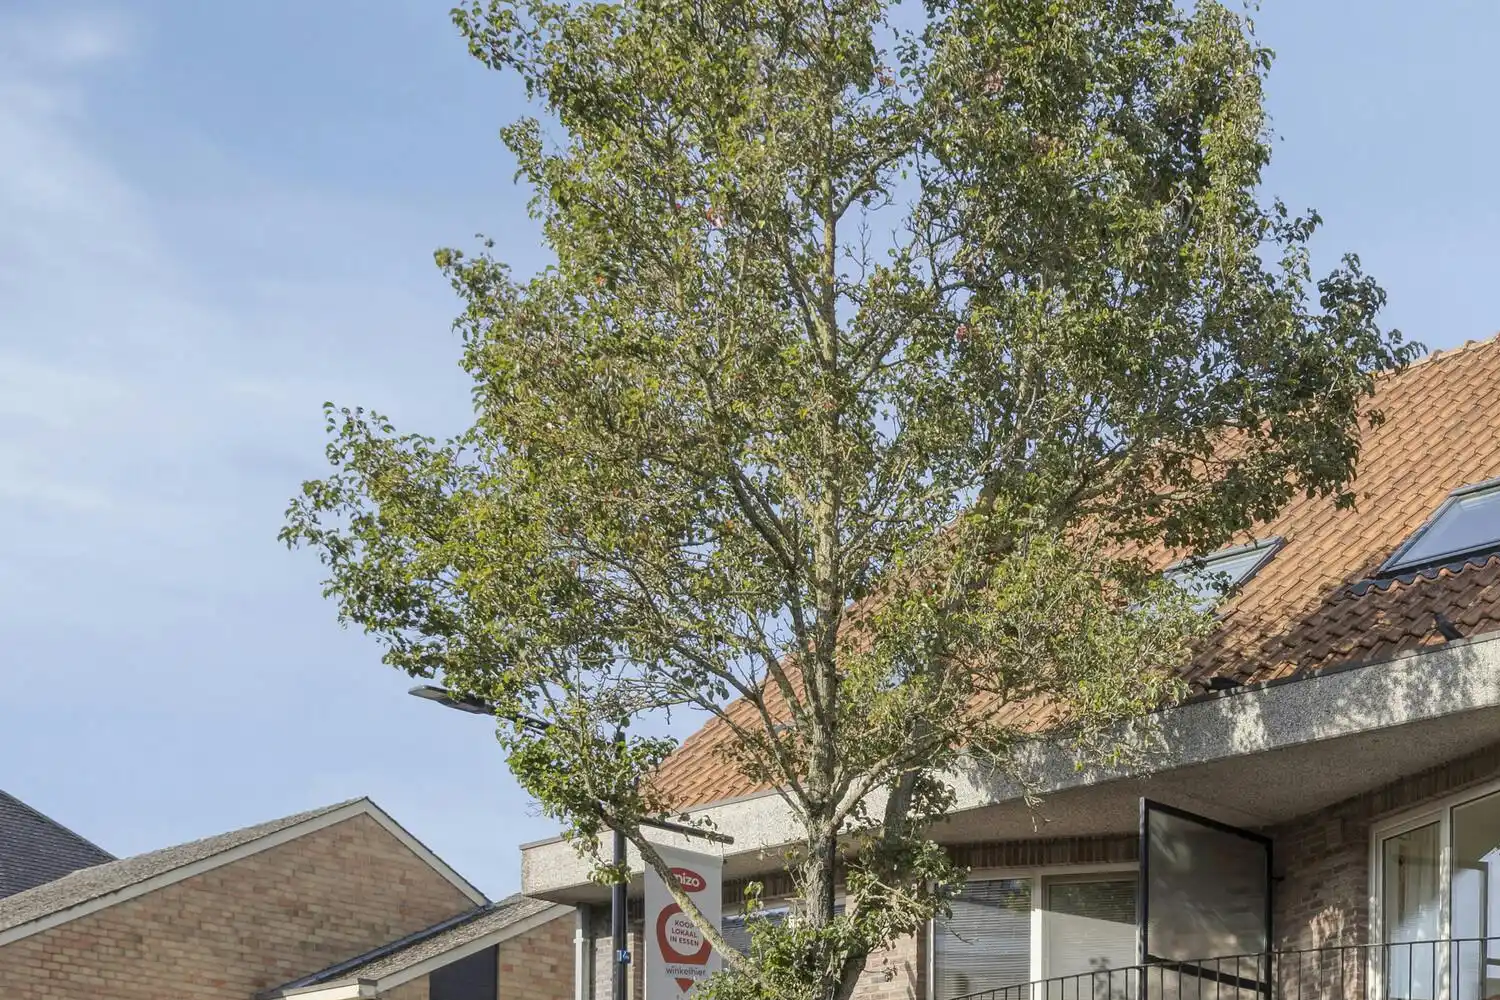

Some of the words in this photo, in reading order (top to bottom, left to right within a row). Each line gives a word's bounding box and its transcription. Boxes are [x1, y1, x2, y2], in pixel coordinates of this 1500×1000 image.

[671, 872, 700, 888] nizo
[674, 919, 695, 929] KOOP
[671, 927, 697, 938] LOKAAL
[669, 935, 678, 943] IN
[679, 937, 699, 947] ESSEN
[665, 965, 706, 976] winkelhier
